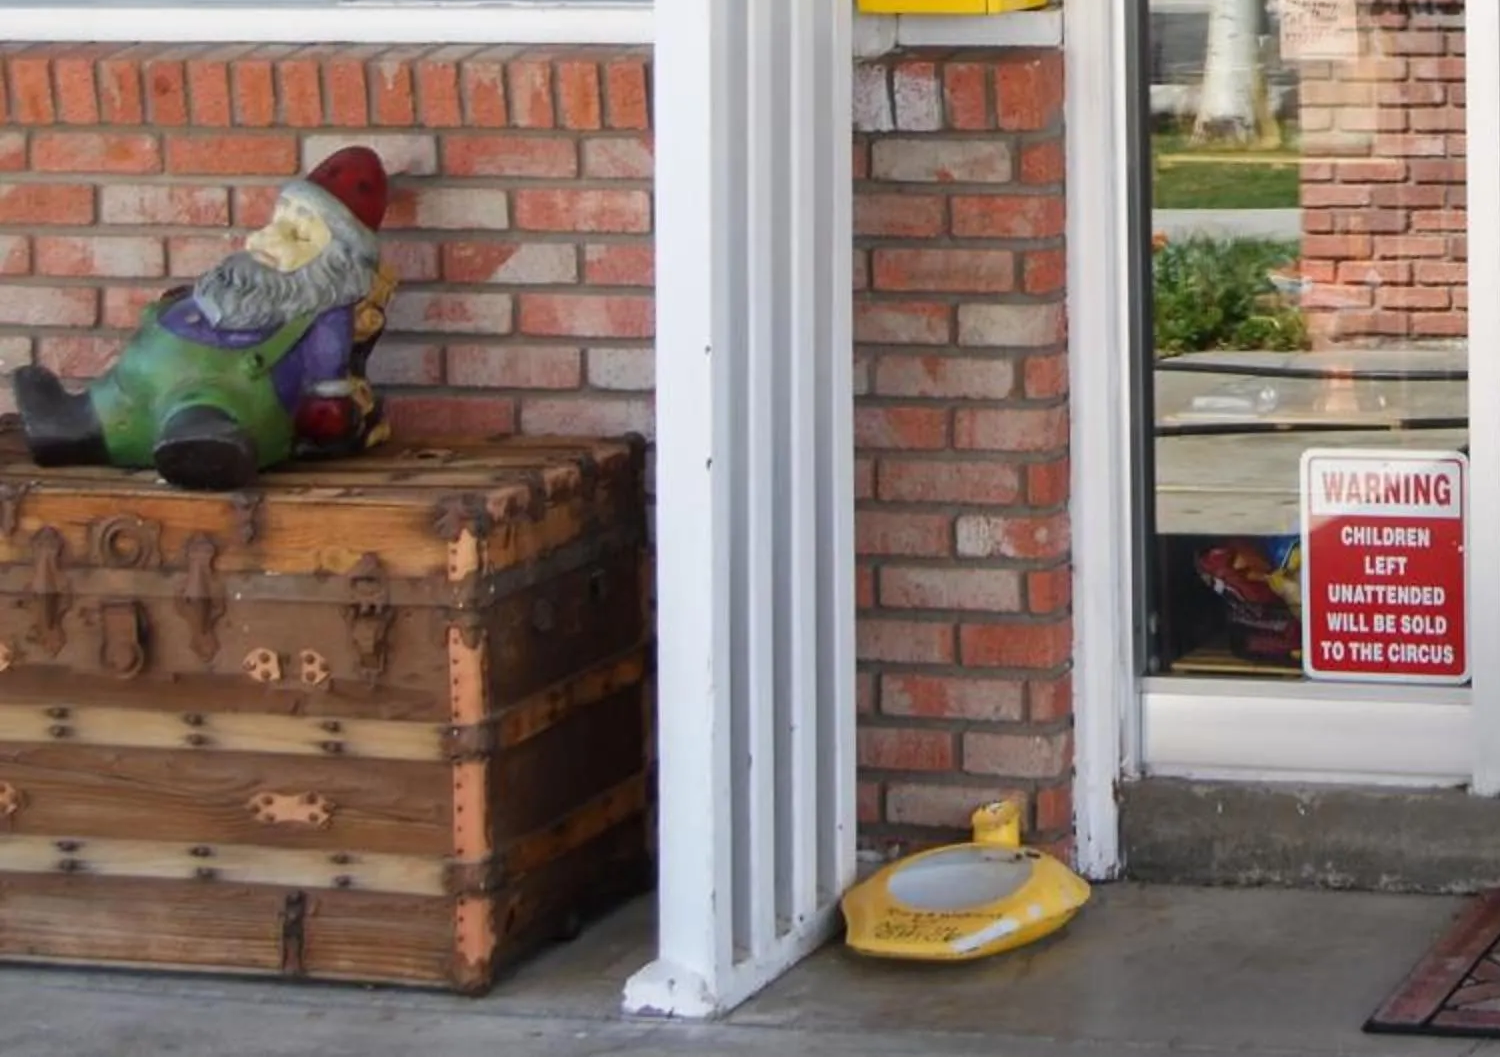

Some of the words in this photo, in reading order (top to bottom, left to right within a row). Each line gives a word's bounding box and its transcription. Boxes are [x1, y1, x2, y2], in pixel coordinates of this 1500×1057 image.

[1322, 471, 1451, 506] WARNING
[1340, 525, 1431, 547] CHILDREN
[1364, 555, 1408, 576] LEFT
[1327, 583, 1446, 605] UNATTENDED
[1326, 612, 1369, 633] WILL
[1373, 614, 1398, 634] BE
[1400, 614, 1447, 636] SOLD
[1320, 642, 1345, 661] TO
[1349, 642, 1384, 662] THE
[1387, 644, 1455, 665] CIRCUS
